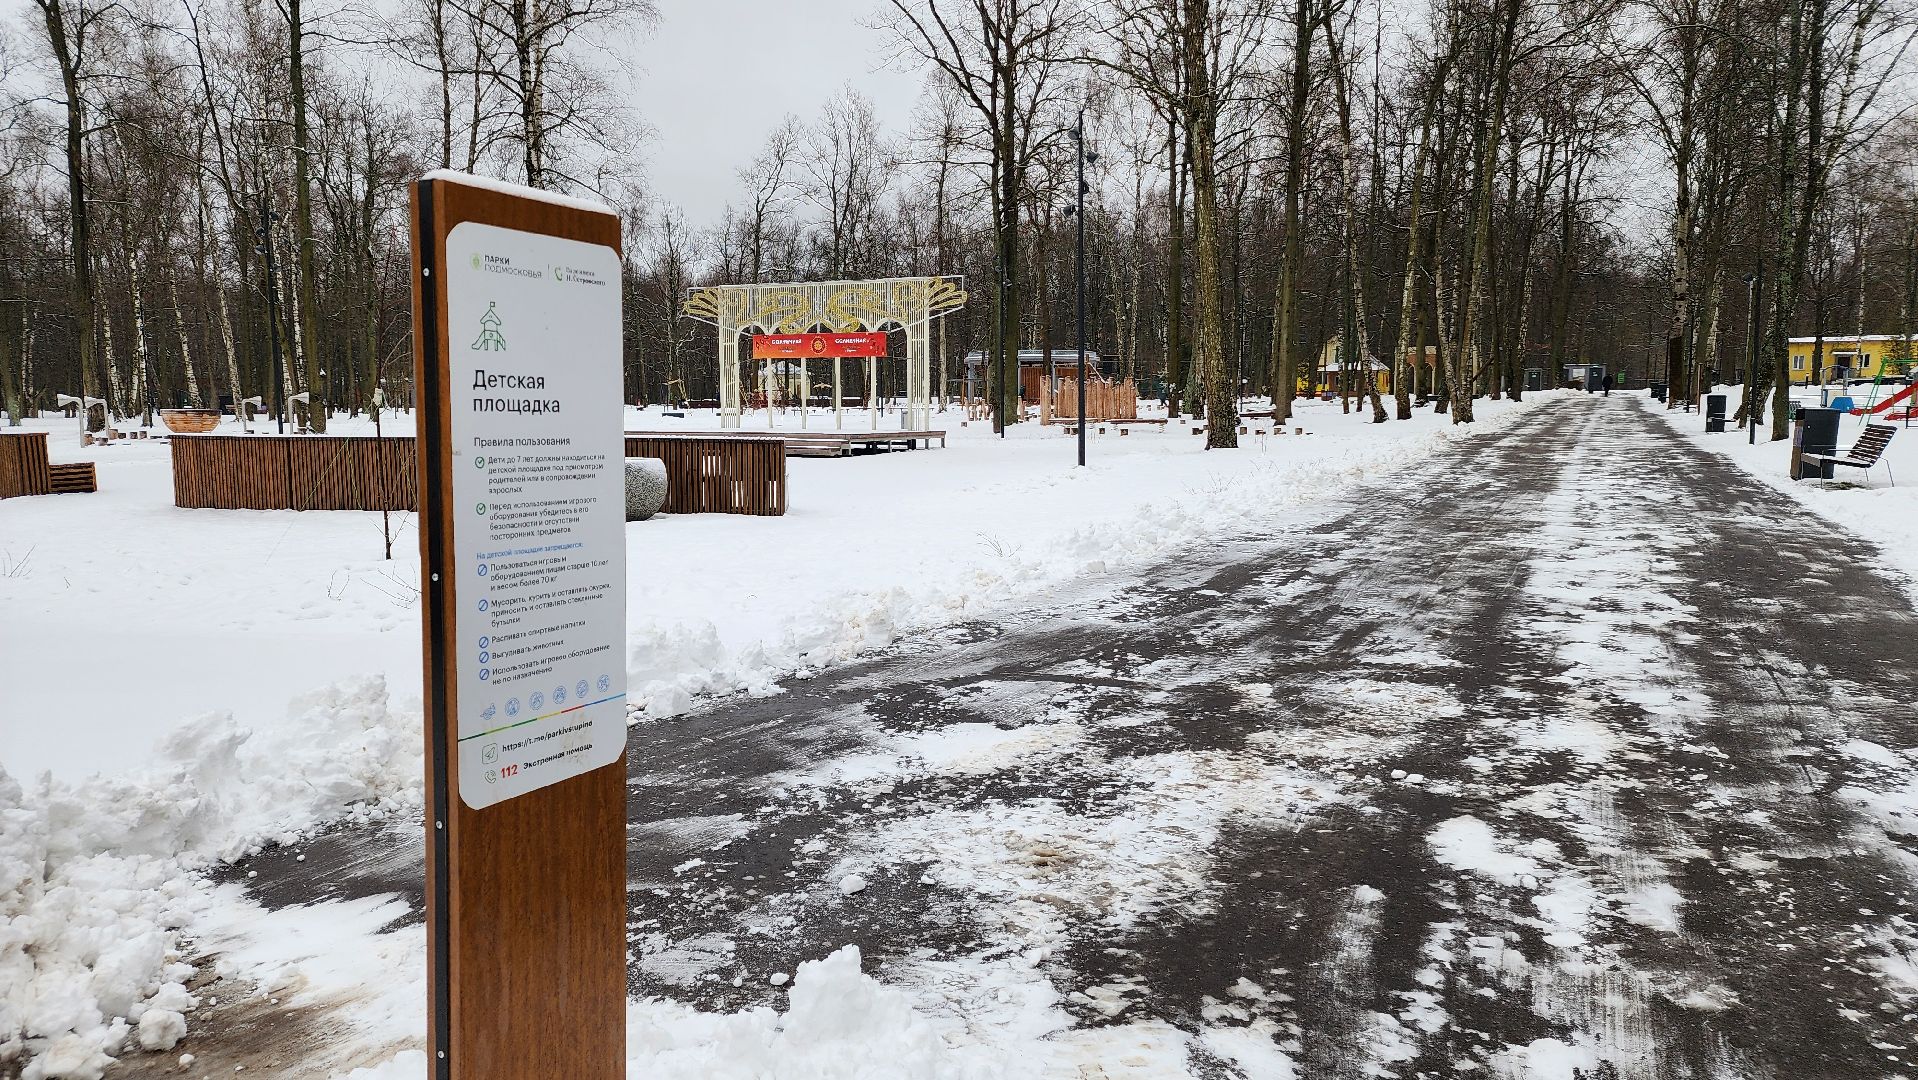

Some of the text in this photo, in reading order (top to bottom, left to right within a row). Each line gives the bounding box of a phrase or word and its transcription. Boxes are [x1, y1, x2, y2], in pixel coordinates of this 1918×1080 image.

[484, 254, 510, 265] ПАРКИ
[484, 264, 542, 279] ПОДМОСКОВЬЯ
[473, 369, 545, 390] Детская
[473, 398, 560, 415] площадка
[474, 437, 571, 448] Правила пользования
[488, 456, 506, 465] Дети
[507, 456, 516, 465] до
[516, 455, 521, 463] 7
[535, 456, 561, 464] должны
[488, 466, 517, 475] детской
[565, 463, 604, 471] присмотром
[488, 475, 526, 485] родителей
[546, 473, 596, 482] сопровождении
[488, 486, 523, 495] взрослых
[489, 496, 597, 512] Перед использованием игрового
[489, 511, 538, 521] оборудования
[539, 508, 573, 517] убедитесь
[489, 520, 537, 531] безопасности
[545, 516, 580, 527] отсутствии
[490, 527, 572, 541] посторонних предметов
[476, 552, 486, 560] На
[486, 549, 513, 559] детской
[490, 559, 538, 572] Пользоваться
[490, 568, 545, 582] оборудованием
[546, 565, 566, 574] лицам
[567, 562, 590, 571] старше
[490, 575, 558, 592] и весом более 70 кг
[528, 593, 551, 602] курить
[557, 587, 588, 597] оставлять
[491, 606, 528, 618] приносить
[535, 599, 567, 610] оставлять
[567, 593, 603, 604] стеклянные
[491, 617, 521, 628] бутылки
[491, 620, 586, 643] Распивать спиртные напитки
[492, 639, 564, 660] Выгуливать животных
[492, 644, 611, 676] Использовать игровое оборудование
[492, 666, 553, 686] не по назначению
[501, 743, 593, 778] 112 Экстренная помощь
